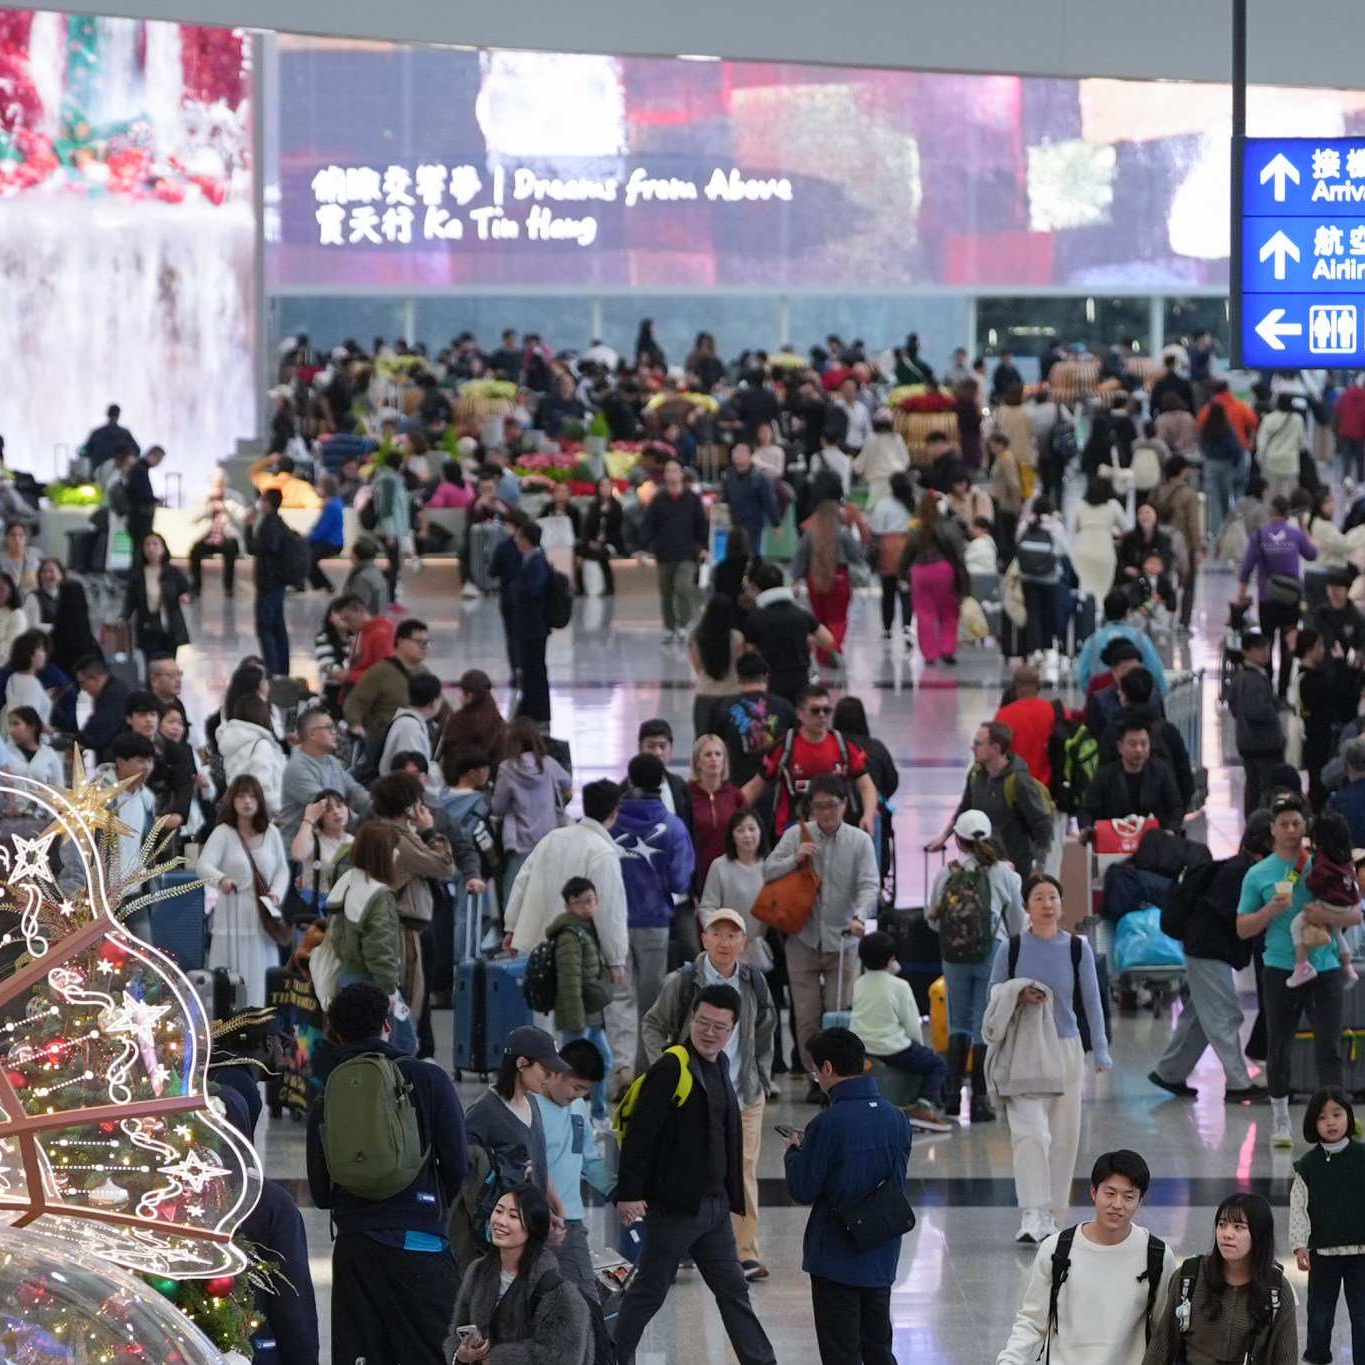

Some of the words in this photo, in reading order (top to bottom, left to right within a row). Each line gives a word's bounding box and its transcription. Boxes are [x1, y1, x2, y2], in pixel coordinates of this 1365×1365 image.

[513, 168, 618, 201] Dreams
[625, 168, 697, 206] from
[704, 168, 793, 201] Above
[424, 204, 463, 240] Ka
[470, 206, 519, 240] Tin
[526, 204, 597, 246] Hang
